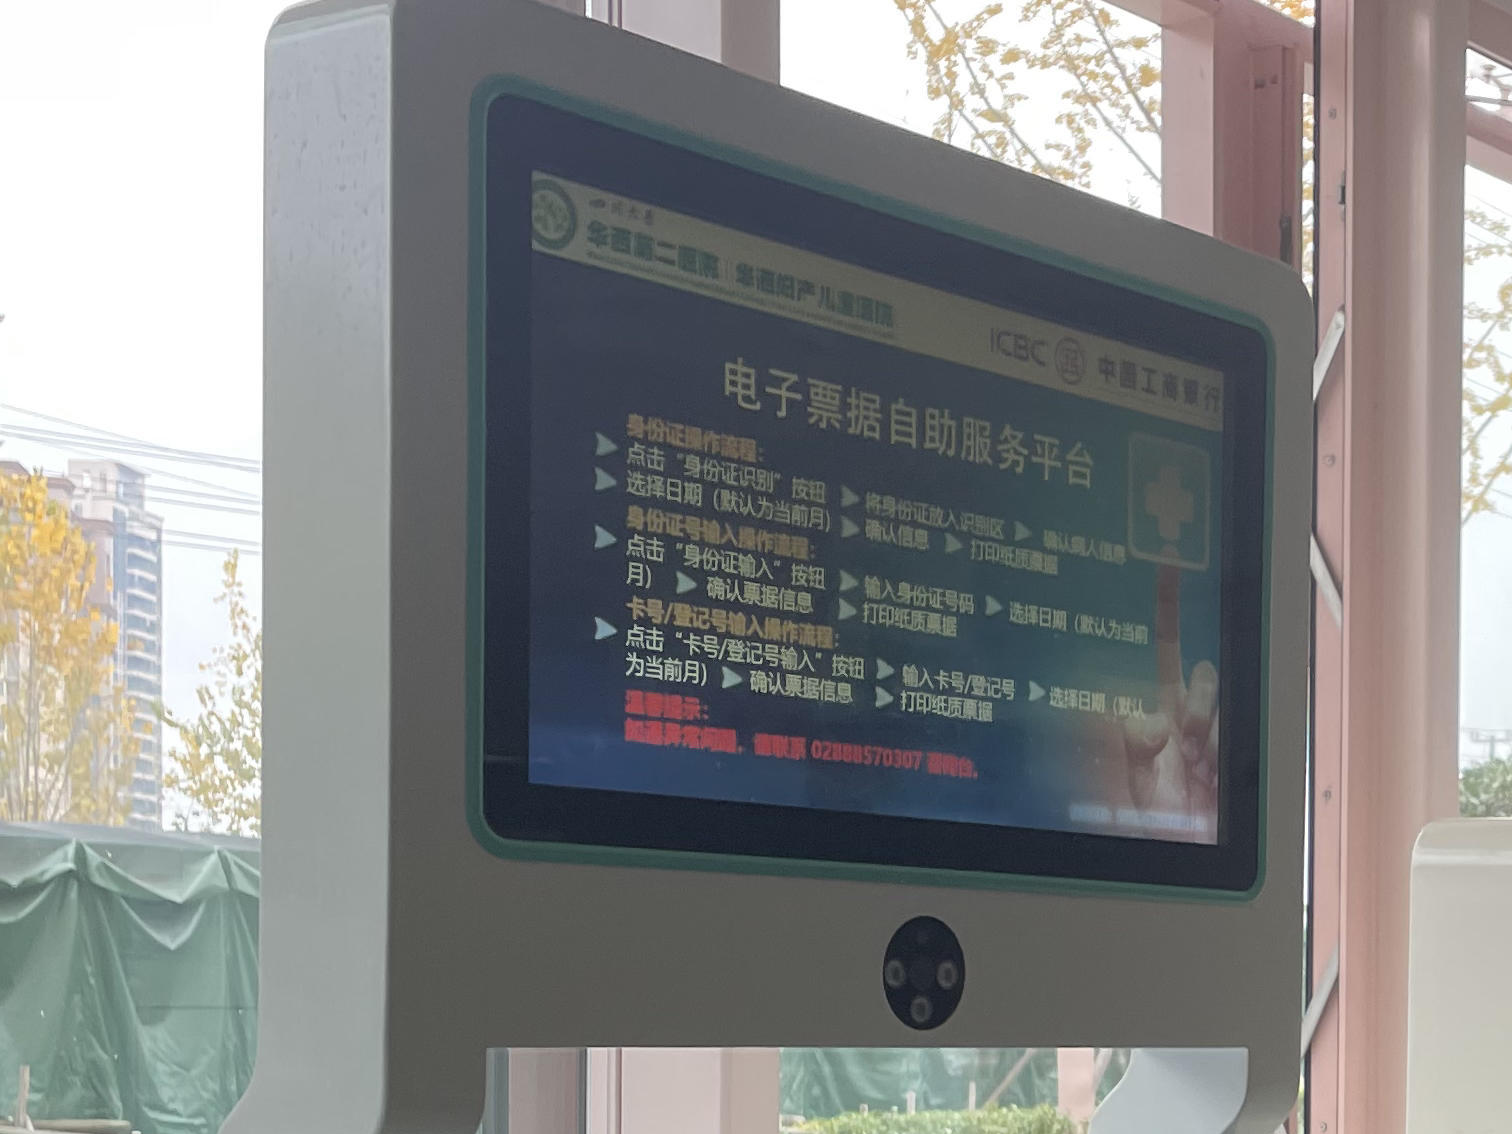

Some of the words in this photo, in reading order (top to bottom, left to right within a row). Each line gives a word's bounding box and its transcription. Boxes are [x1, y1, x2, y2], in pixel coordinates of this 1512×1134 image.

[989, 327, 1049, 367] ICBC
[1096, 352, 1220, 413] 中国工商银行
[722, 357, 1094, 488] 电子票据自助服务平台
[969, 538, 1059, 576] 打印纸质票据
[706, 576, 814, 615] 确认票据信息
[862, 601, 958, 639] 打印纸质票据
[864, 574, 975, 616] 输入身份证号码
[749, 669, 853, 705] 确认票据信息
[900, 690, 994, 723] 打印纸质票据
[901, 663, 1017, 701] 输入卡号/登记号
